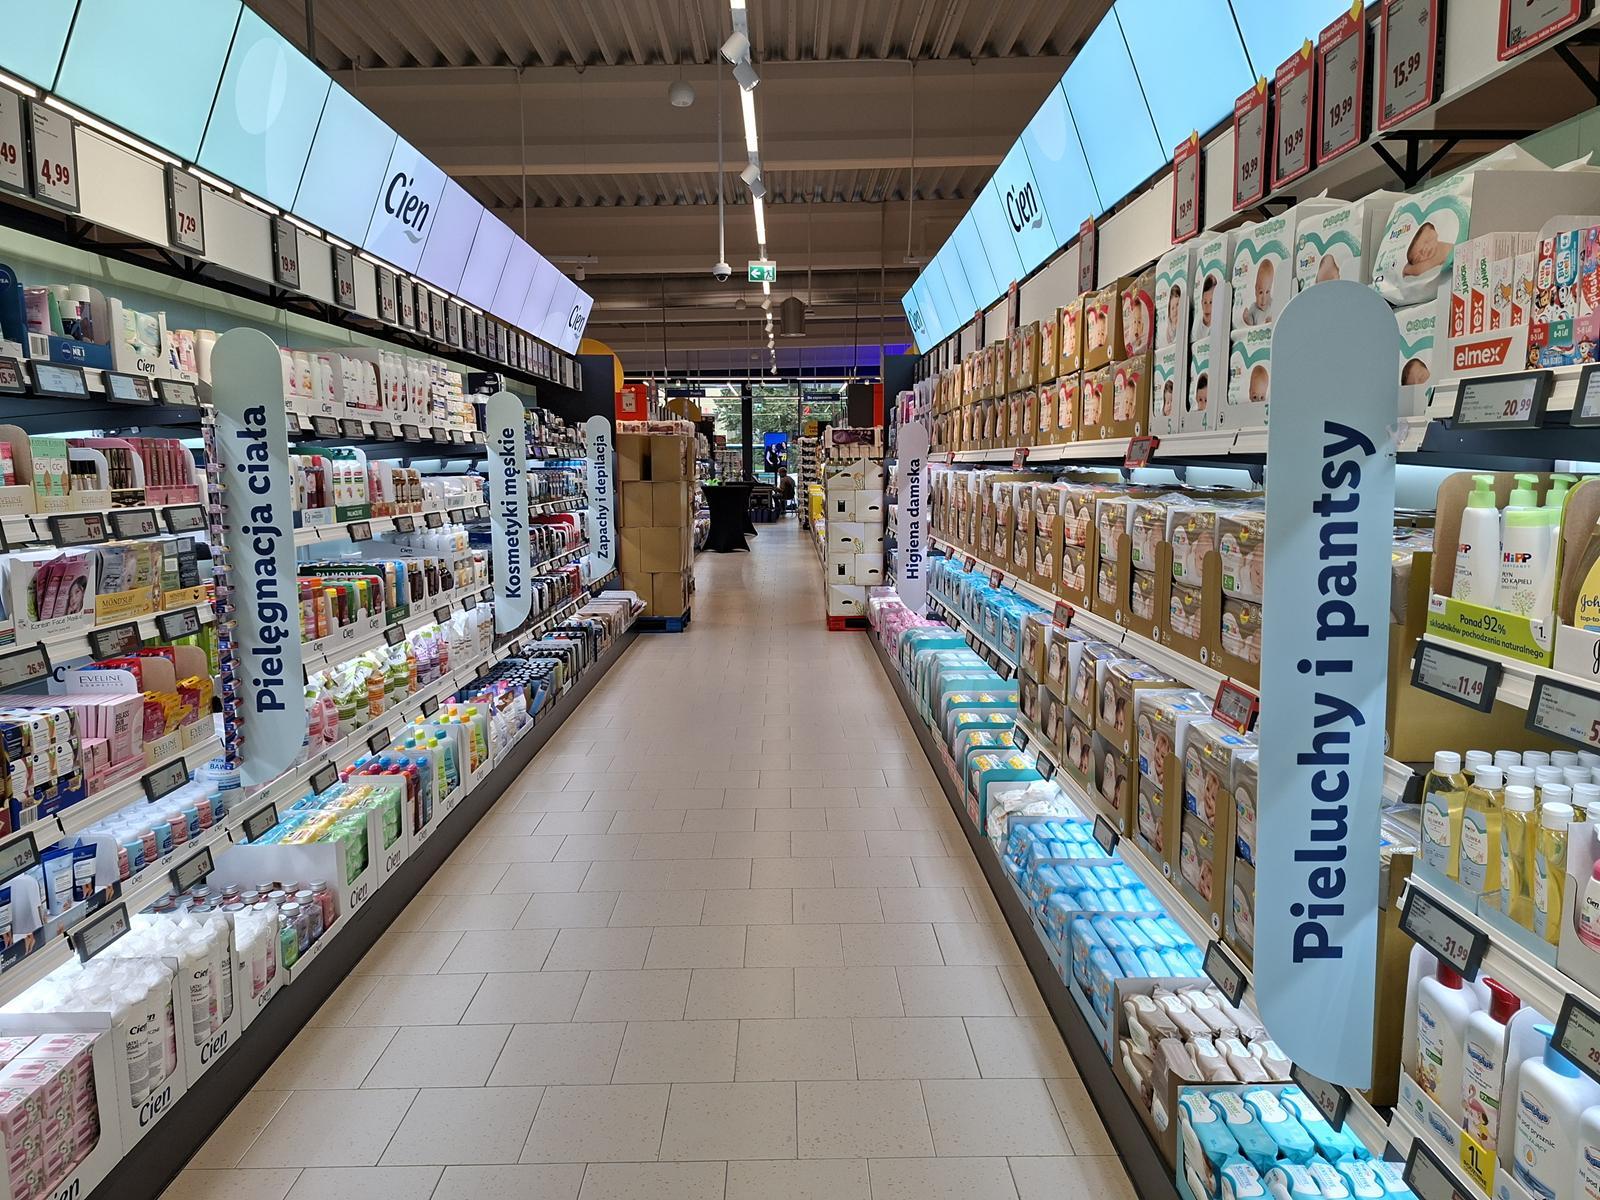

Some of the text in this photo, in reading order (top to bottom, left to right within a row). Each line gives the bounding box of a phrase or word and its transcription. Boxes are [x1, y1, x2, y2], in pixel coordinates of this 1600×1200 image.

[1393, 52, 1421, 88] 15.99
[1330, 96, 1353, 128] 19.99
[1284, 128, 1304, 156] 19.99
[41, 159, 70, 186] 4.99
[1241, 157, 1258, 182] 19.99
[385, 172, 430, 232] Cien
[1006, 181, 1038, 233] Cien
[1179, 199, 1192, 220] 19.99
[178, 212, 196, 235] 7.29
[281, 255, 296, 274] 19.99
[1481, 257, 1489, 288] JUNIOR
[1461, 264, 1469, 295] JUNIOR
[568, 305, 586, 332] Cien
[136, 358, 155, 373] Cien
[1456, 346, 1501, 367] elmex
[322, 403, 332, 414] Cien
[1503, 398, 1531, 416] 20.99
[1202, 413, 1207, 431] 4
[34, 462, 46, 471] CC+
[51, 463, 63, 471] CC+
[592, 434, 610, 559] Zapachy i depilacja
[498, 428, 523, 599] Kosmetyki męskie
[906, 458, 922, 579] Higiena damska
[142, 521, 153, 533] 6.99
[236, 405, 289, 712] Pielęgnacja ciała
[1503, 552, 1532, 563] HiPP
[343, 628, 354, 638] Cien
[1460, 614, 1507, 635] Ponad 92%
[1429, 619, 1544, 659] składników pochodzenia naturalnego
[27, 660, 45, 675] 26.99
[79, 674, 121, 684] EVELINE
[1290, 420, 1376, 963] Pieluchy i pantsy
[1459, 676, 1483, 696] 11.49
[153, 738, 177, 755] EVELINE
[14, 849, 33, 867] 12.99
[386, 850, 401, 873] Cien
[350, 881, 368, 910] Cien
[1586, 897, 1599, 909] Cien
[1443, 936, 1468, 960] 31.99
[1223, 977, 1236, 994] 6.99
[200, 1029, 228, 1065] Cien
[139, 1086, 171, 1127] Cien
[1319, 1090, 1336, 1113] 5.99
[1468, 1146, 1483, 1175] 1L
